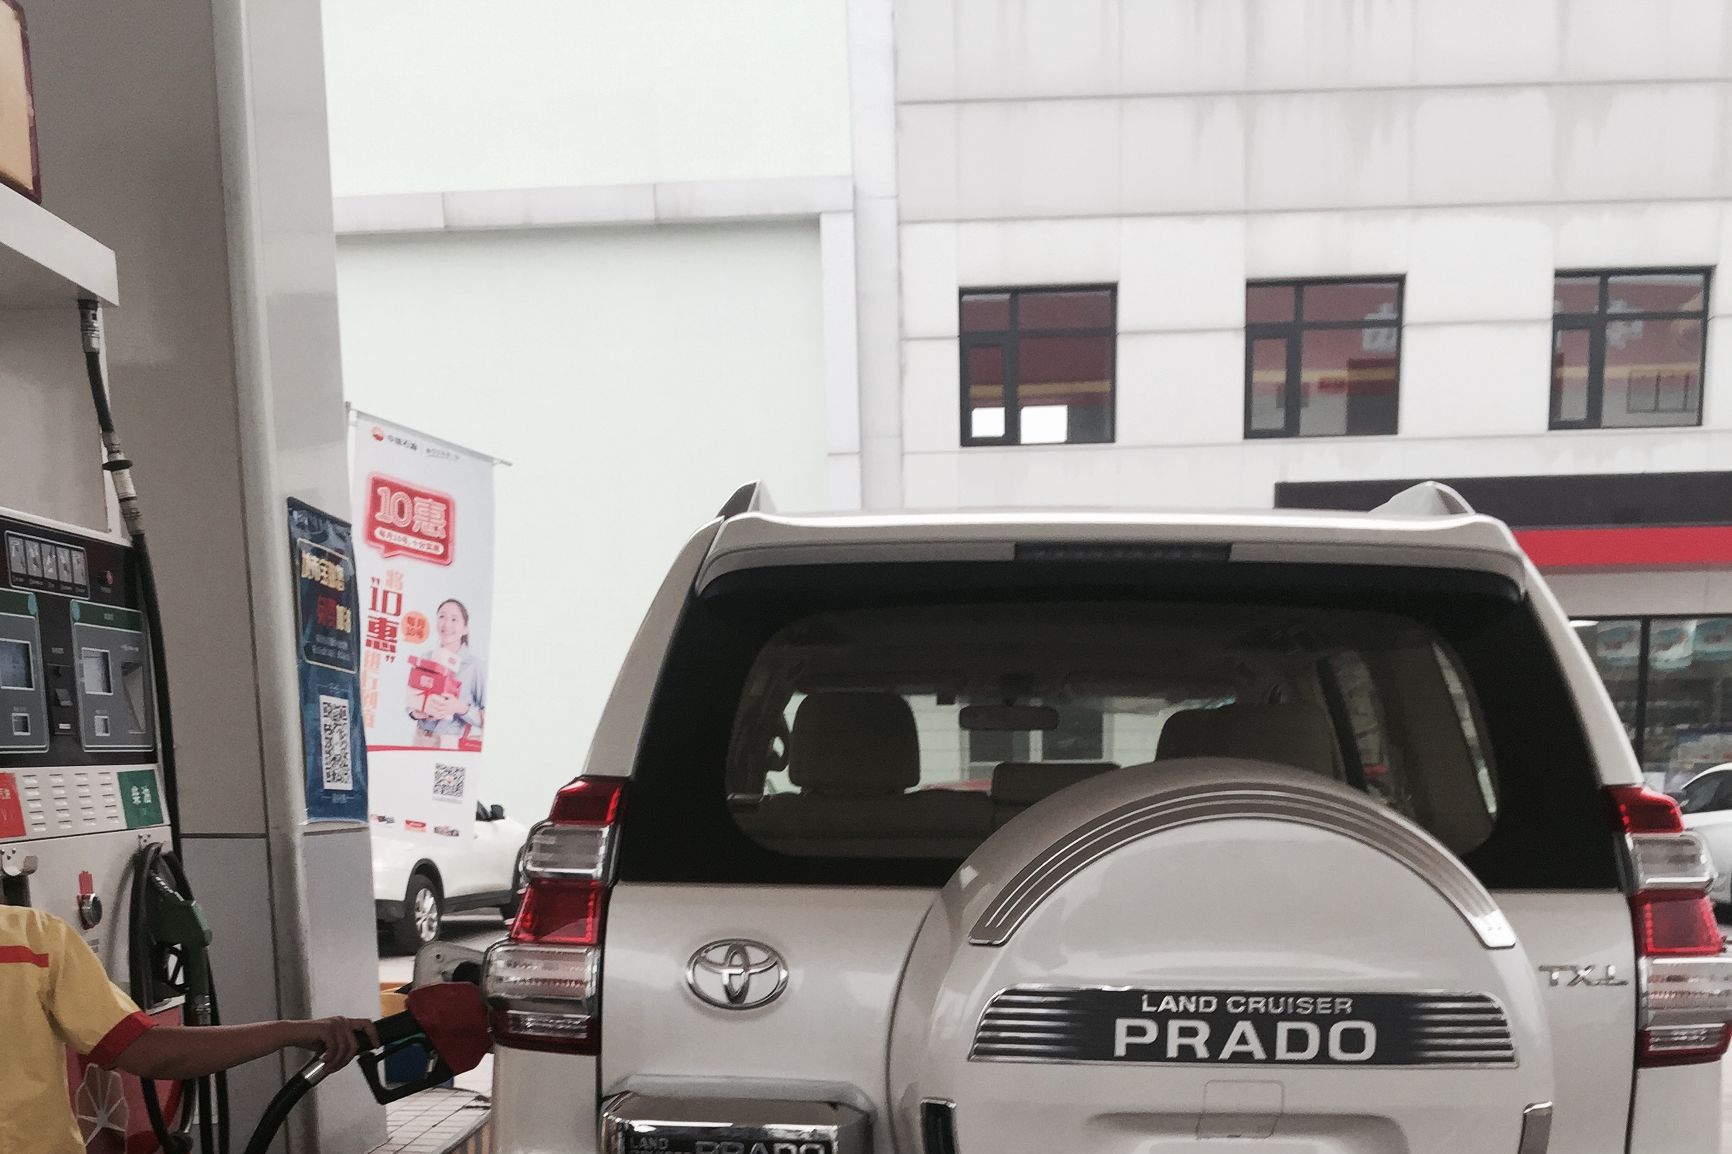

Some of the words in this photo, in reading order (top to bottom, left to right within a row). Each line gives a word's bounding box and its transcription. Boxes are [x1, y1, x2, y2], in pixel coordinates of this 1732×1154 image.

[1141, 994, 1217, 1014] LAND
[1225, 995, 1353, 1015] CRUISER
[1113, 1017, 1377, 1062] PRADO
[629, 1136, 669, 1150] LAND
